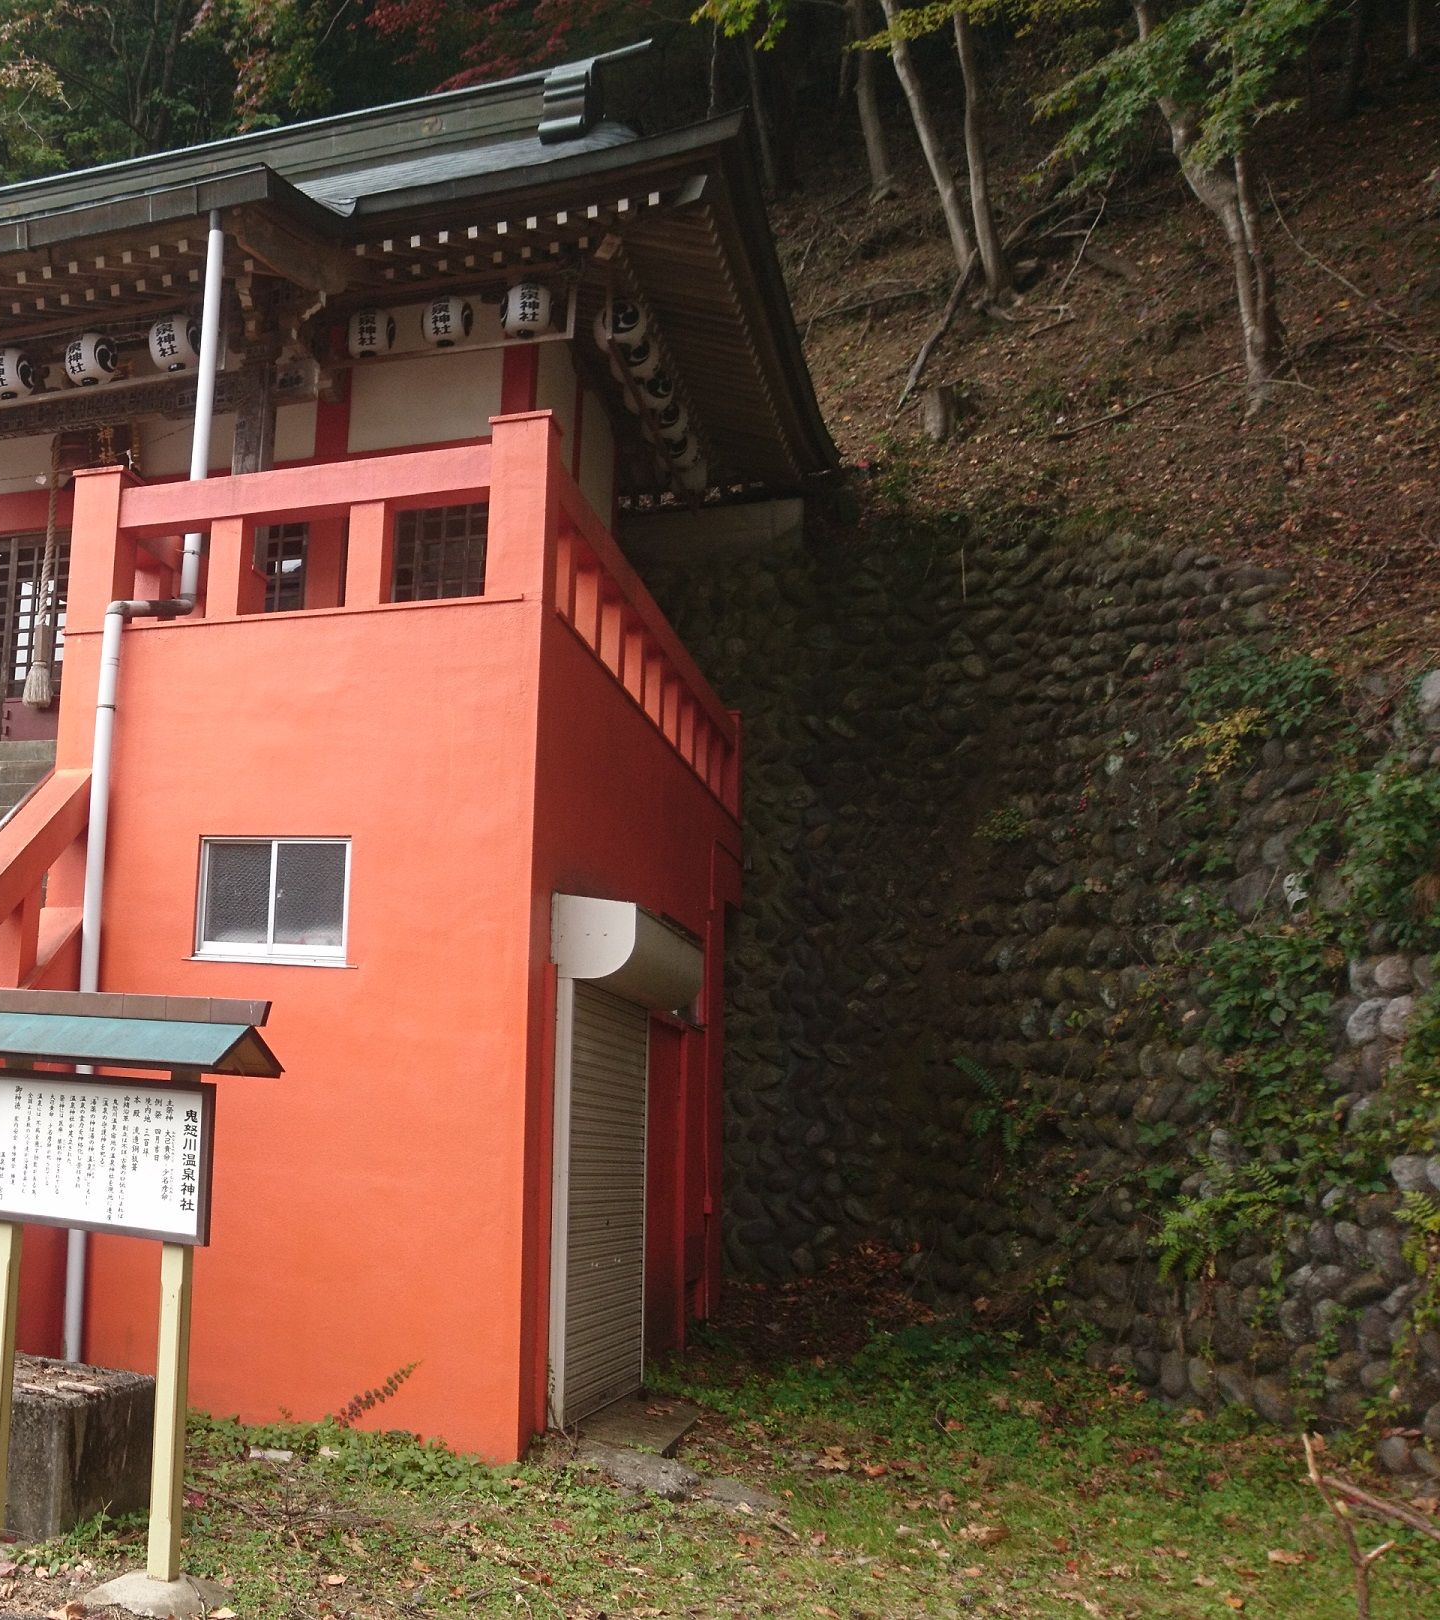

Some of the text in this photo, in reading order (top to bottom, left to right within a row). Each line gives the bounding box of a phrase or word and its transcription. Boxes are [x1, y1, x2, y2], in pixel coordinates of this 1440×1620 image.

[14, 1085, 23, 1110] 御神徳
[143, 1097, 152, 1123] 境内地
[165, 1099, 174, 1122] 主祭神
[154, 1128, 162, 1161] 四月吉日
[180, 1109, 198, 1211] 鬼怒川温泉神社
